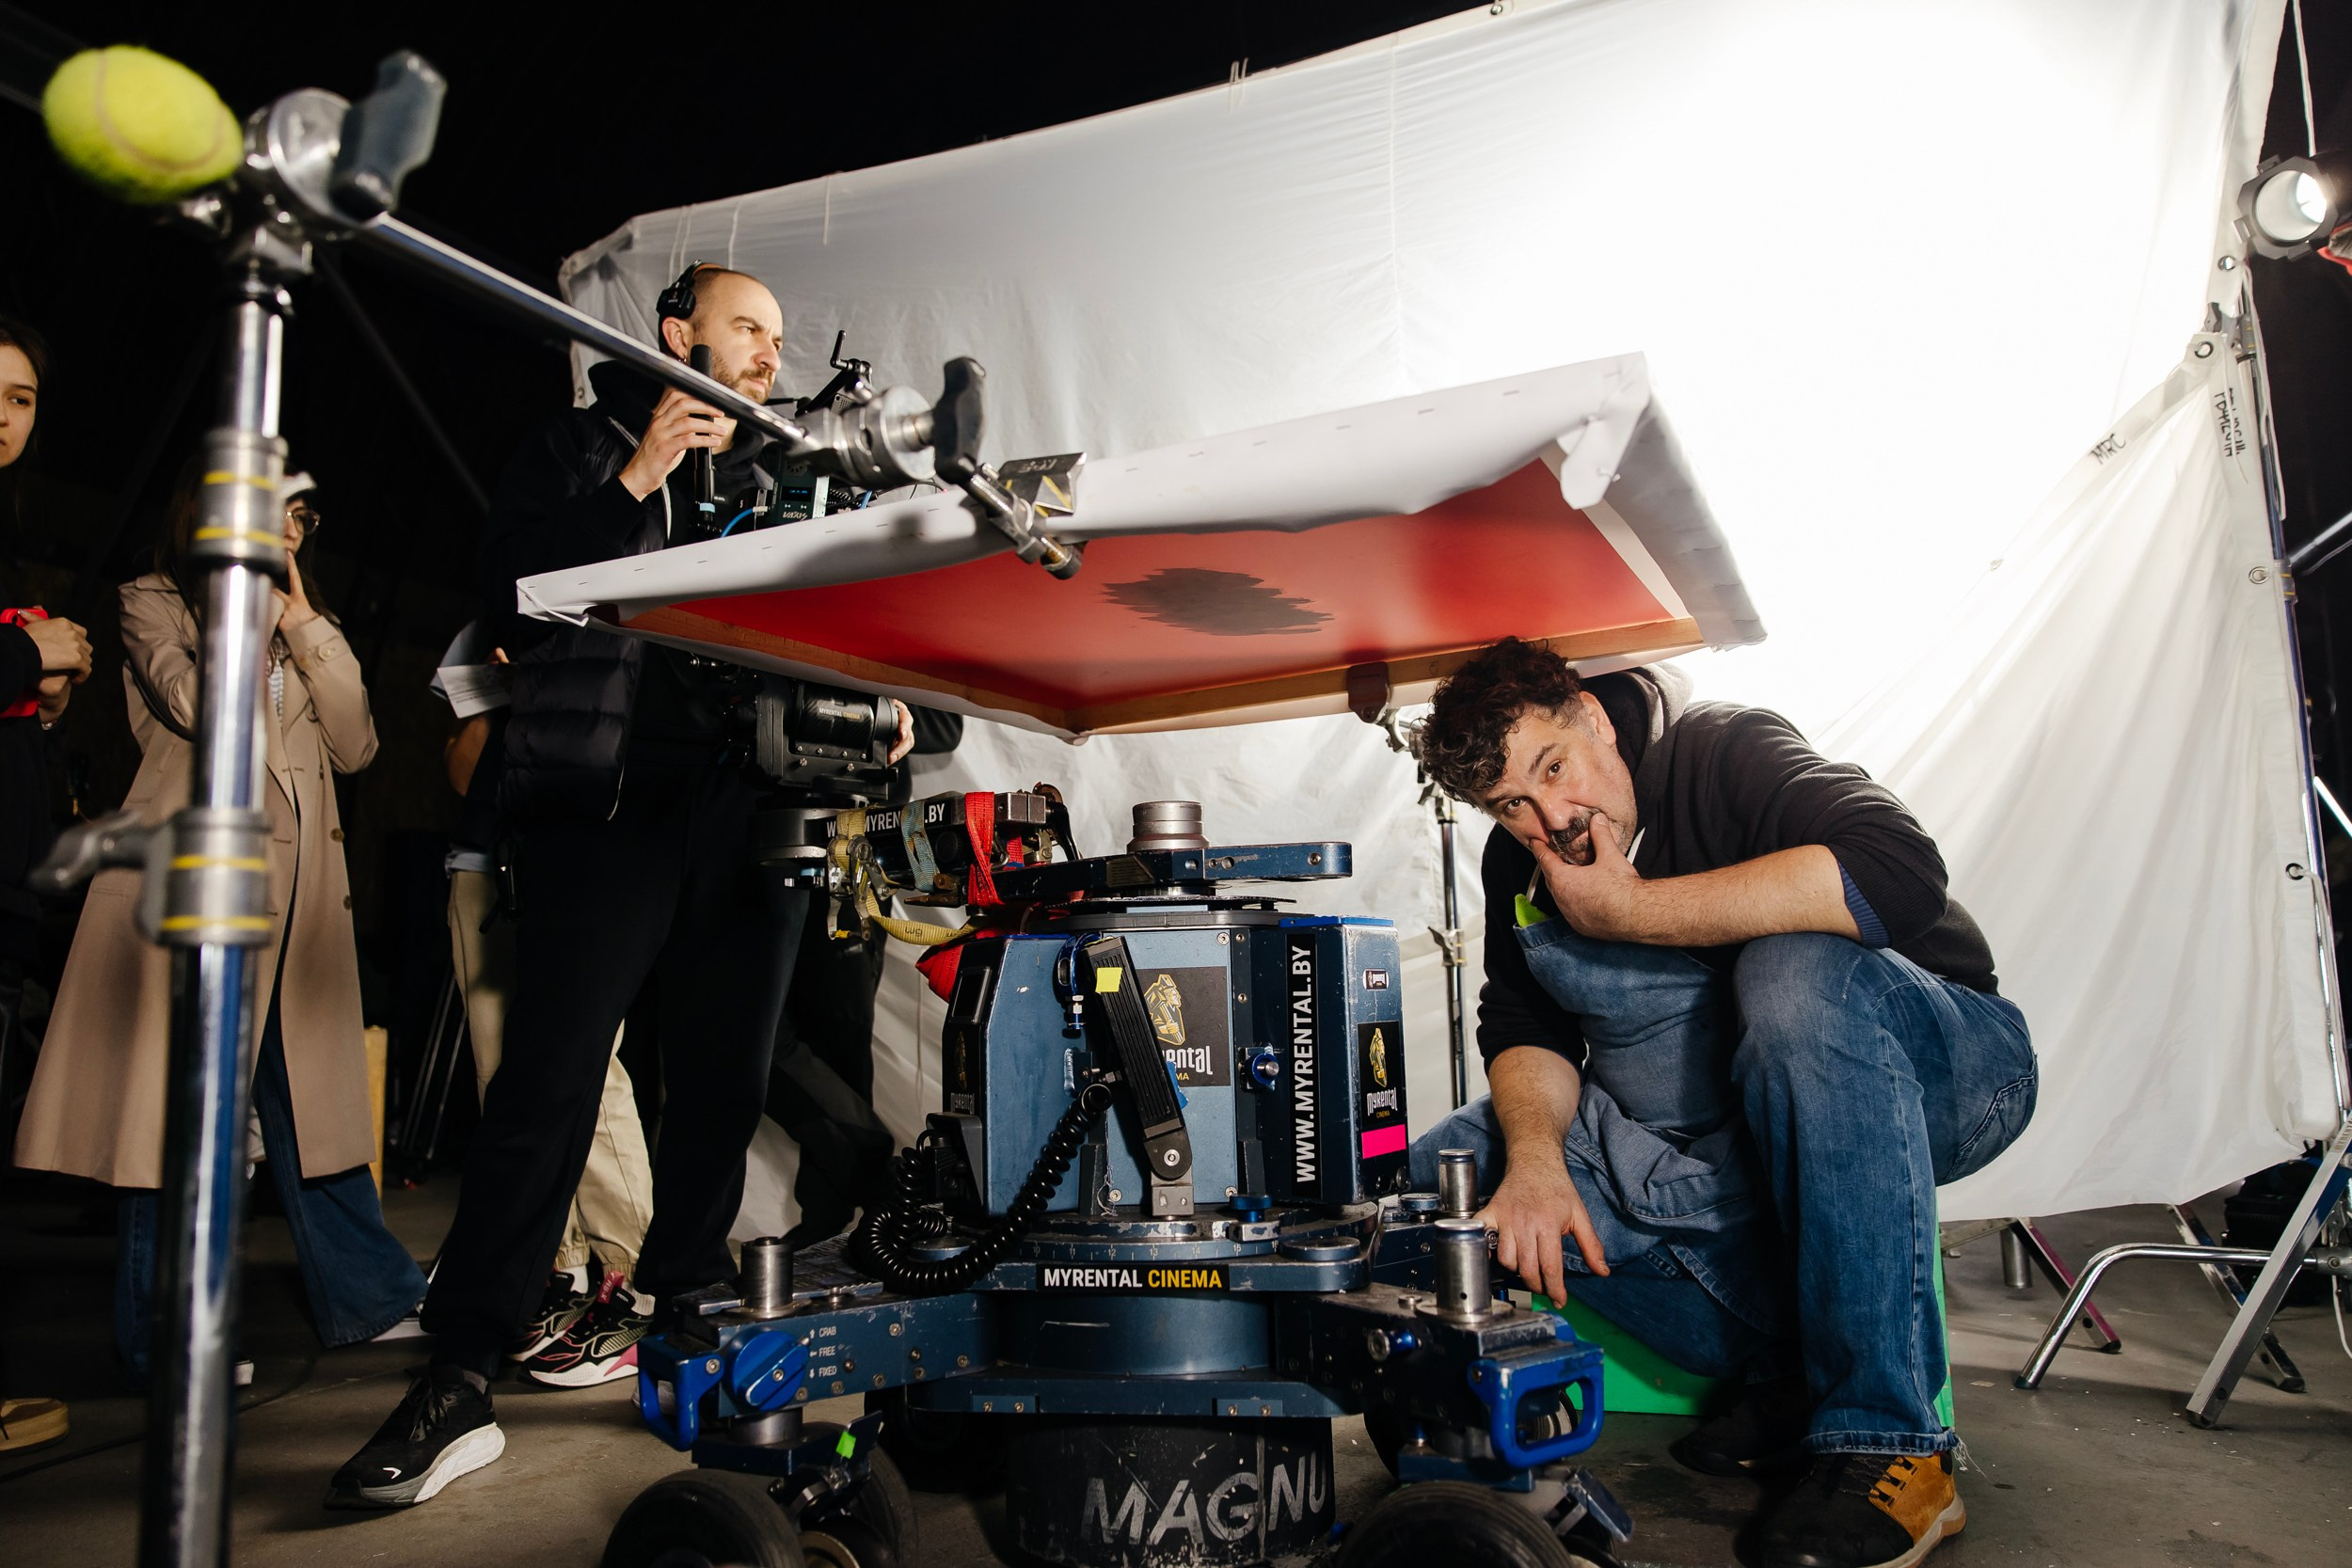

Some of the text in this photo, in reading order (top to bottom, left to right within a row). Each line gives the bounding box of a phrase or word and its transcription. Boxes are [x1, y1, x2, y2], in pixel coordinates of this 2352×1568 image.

[818, 706, 843, 718] MYRENTAL
[1292, 945, 1316, 1183] WWW.MYRENTAL.BY
[1043, 1268, 1223, 1289] MYRENTAL CINEMA
[818, 1325, 837, 1338] CRAB
[818, 1345, 836, 1357] FREE
[818, 1365, 837, 1377] FIXED
